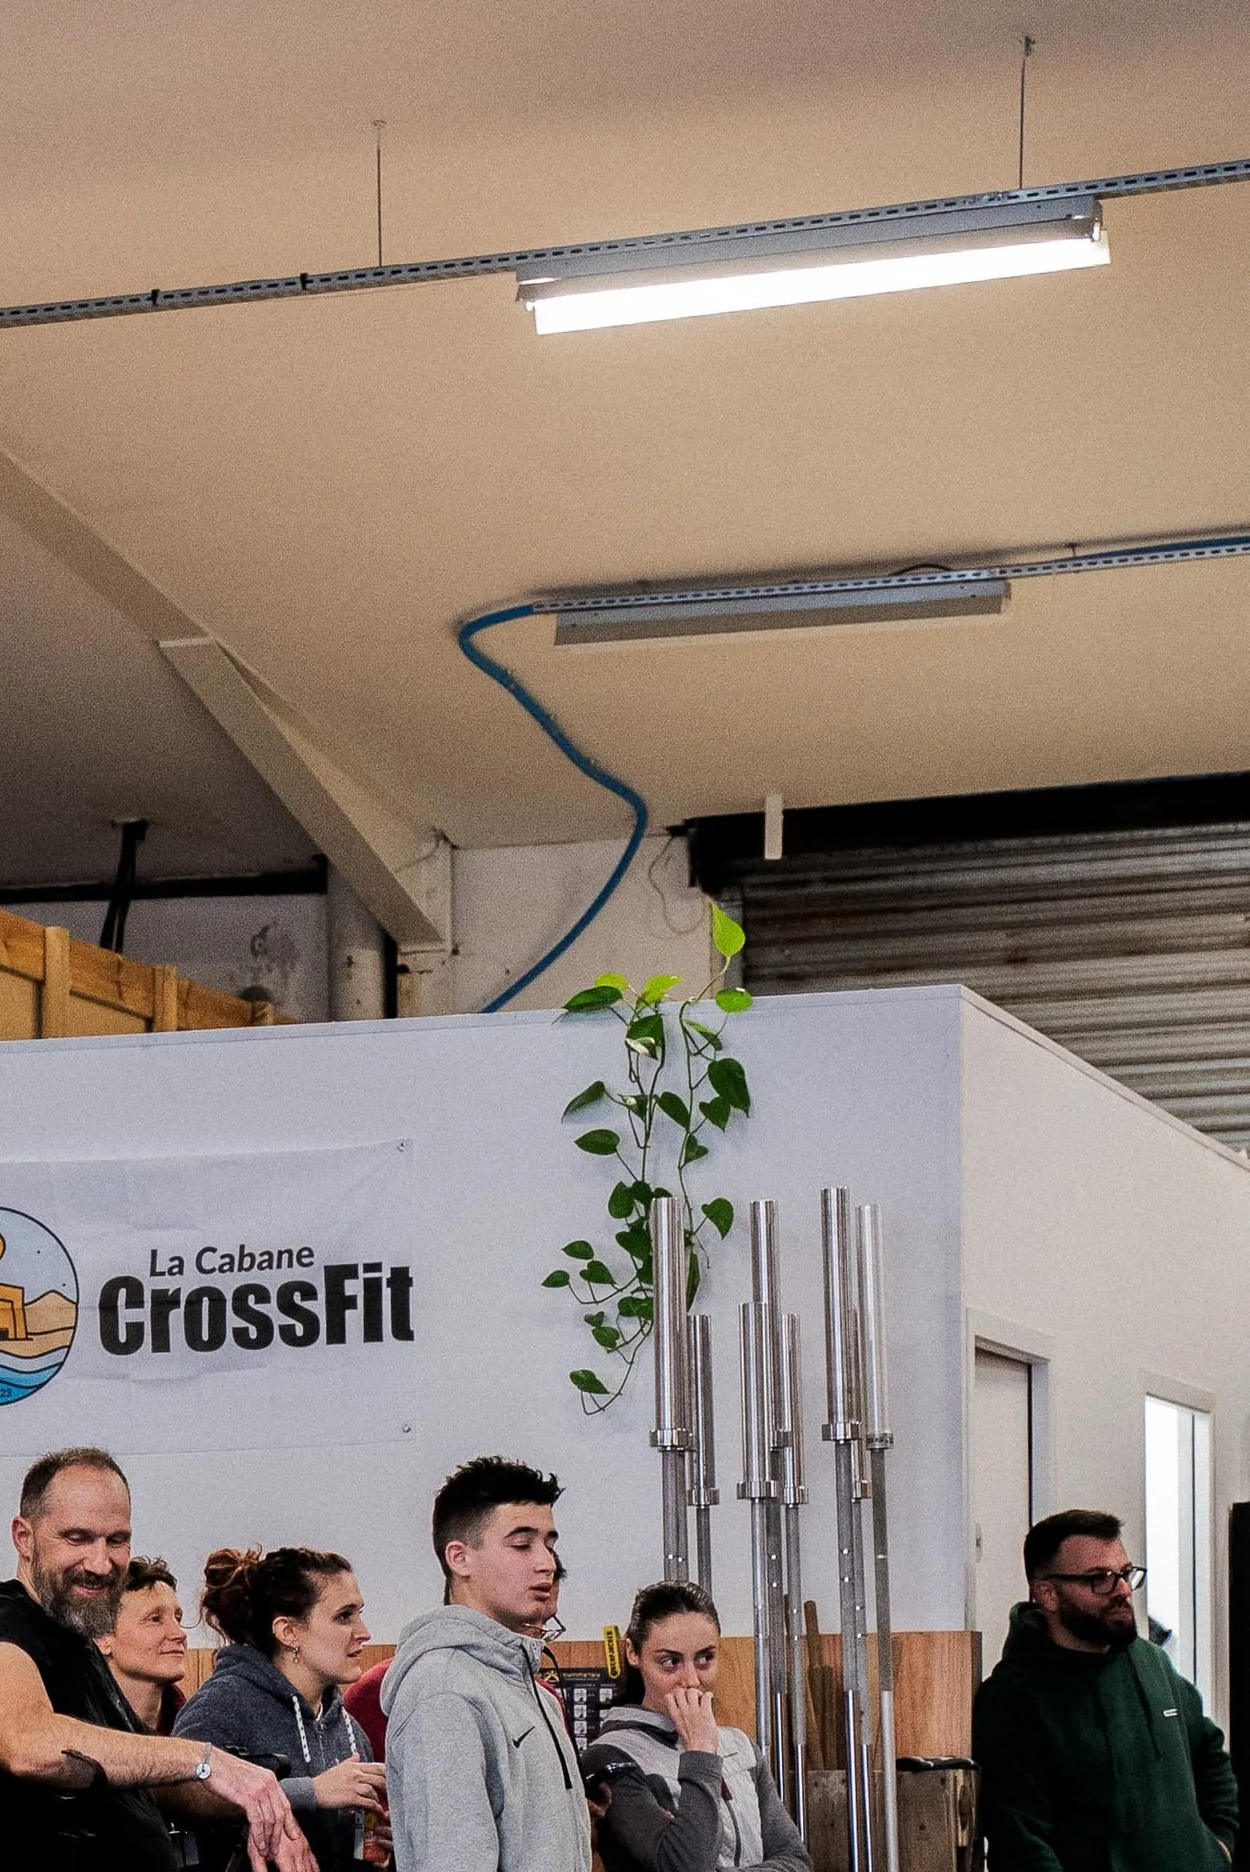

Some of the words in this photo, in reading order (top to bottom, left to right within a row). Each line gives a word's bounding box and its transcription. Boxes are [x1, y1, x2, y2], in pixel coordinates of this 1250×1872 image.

[149, 1248, 185, 1278] La
[195, 1243, 316, 1275] Cabane
[98, 1262, 415, 1356] CrossFit
